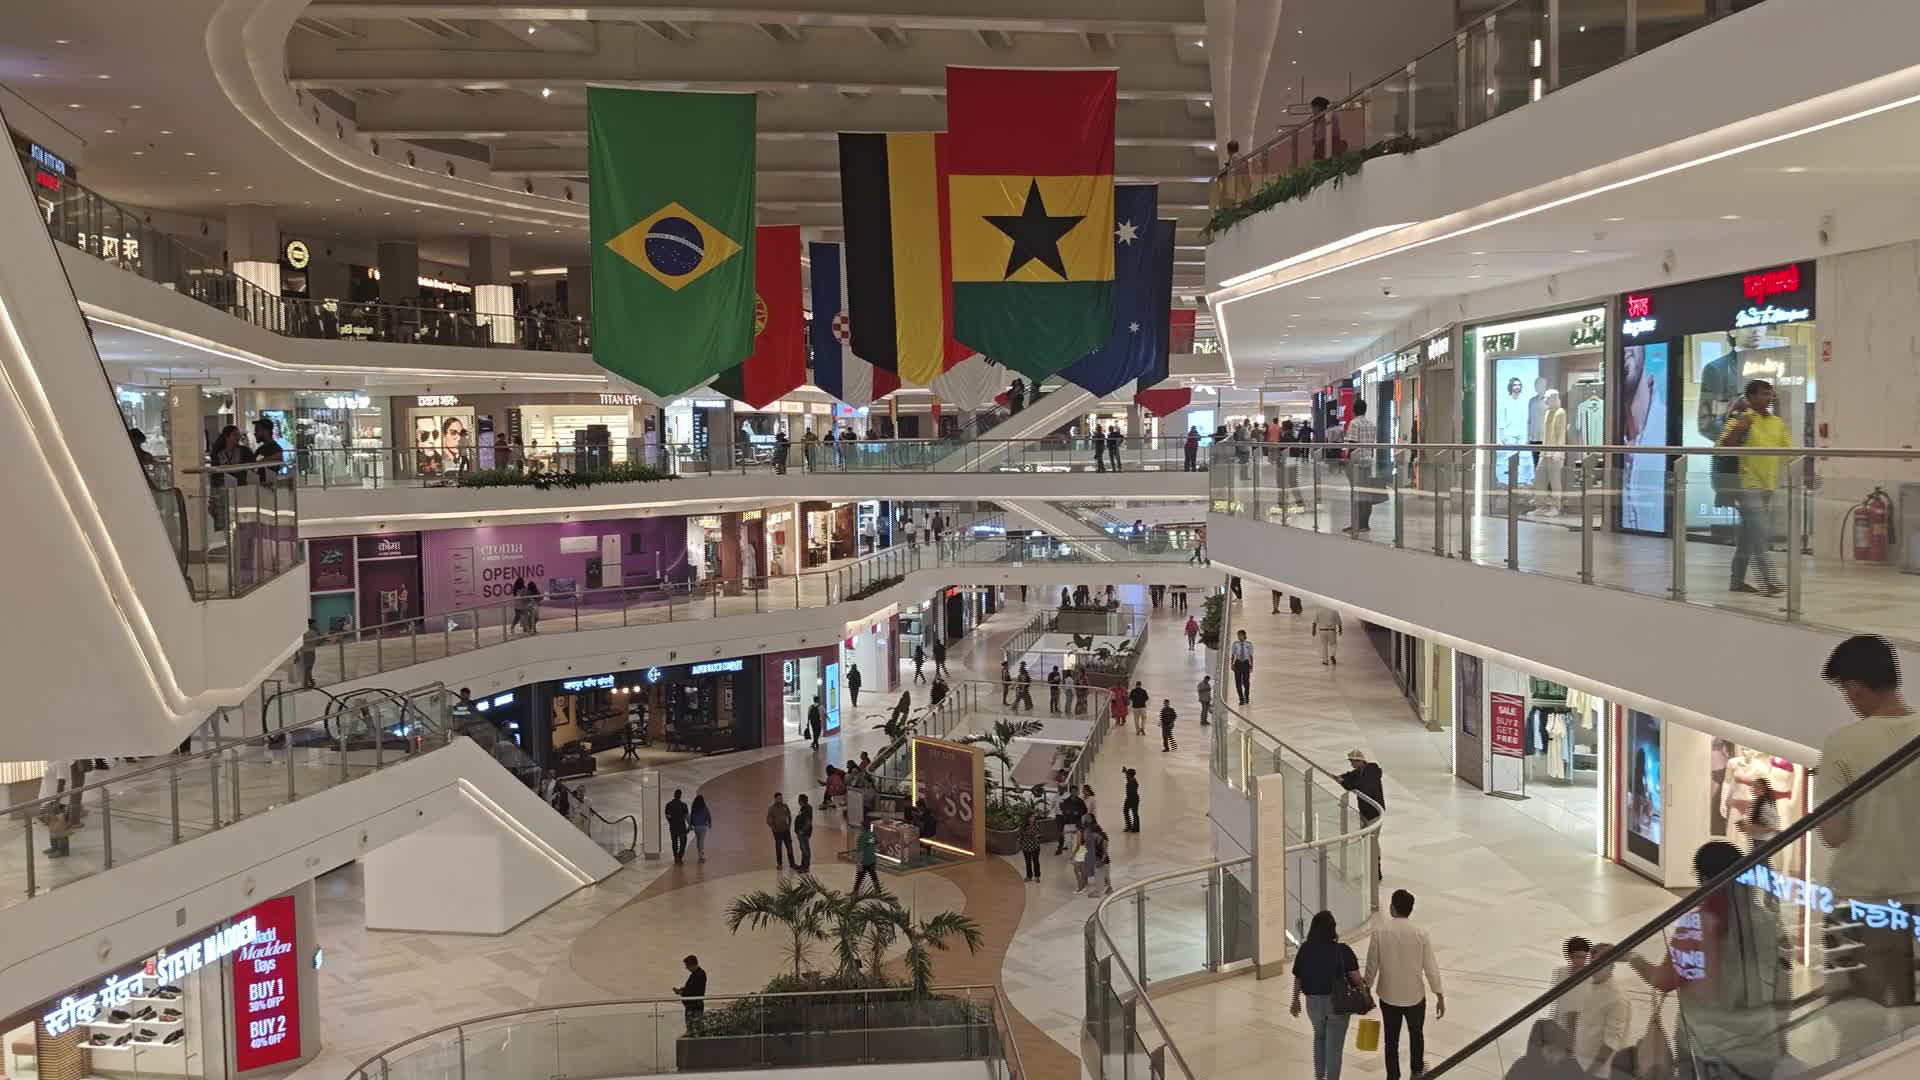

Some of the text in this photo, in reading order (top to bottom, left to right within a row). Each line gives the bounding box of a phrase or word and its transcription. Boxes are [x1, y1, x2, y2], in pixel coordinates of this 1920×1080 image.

[600, 394, 643, 405] TITAN EYE+
[482, 564, 544, 581] OPENING
[483, 583, 516, 598] SOO
[1498, 706, 1517, 715] SALE
[1496, 716, 1512, 726] BUY
[1496, 726, 1513, 735] GET
[1496, 735, 1519, 744] FREE
[157, 915, 259, 986] STEVE MADDEN
[239, 940, 292, 962] Madden
[254, 959, 276, 974] Days
[249, 978, 284, 1001] BUY 1
[250, 1015, 287, 1039] BUY 2
